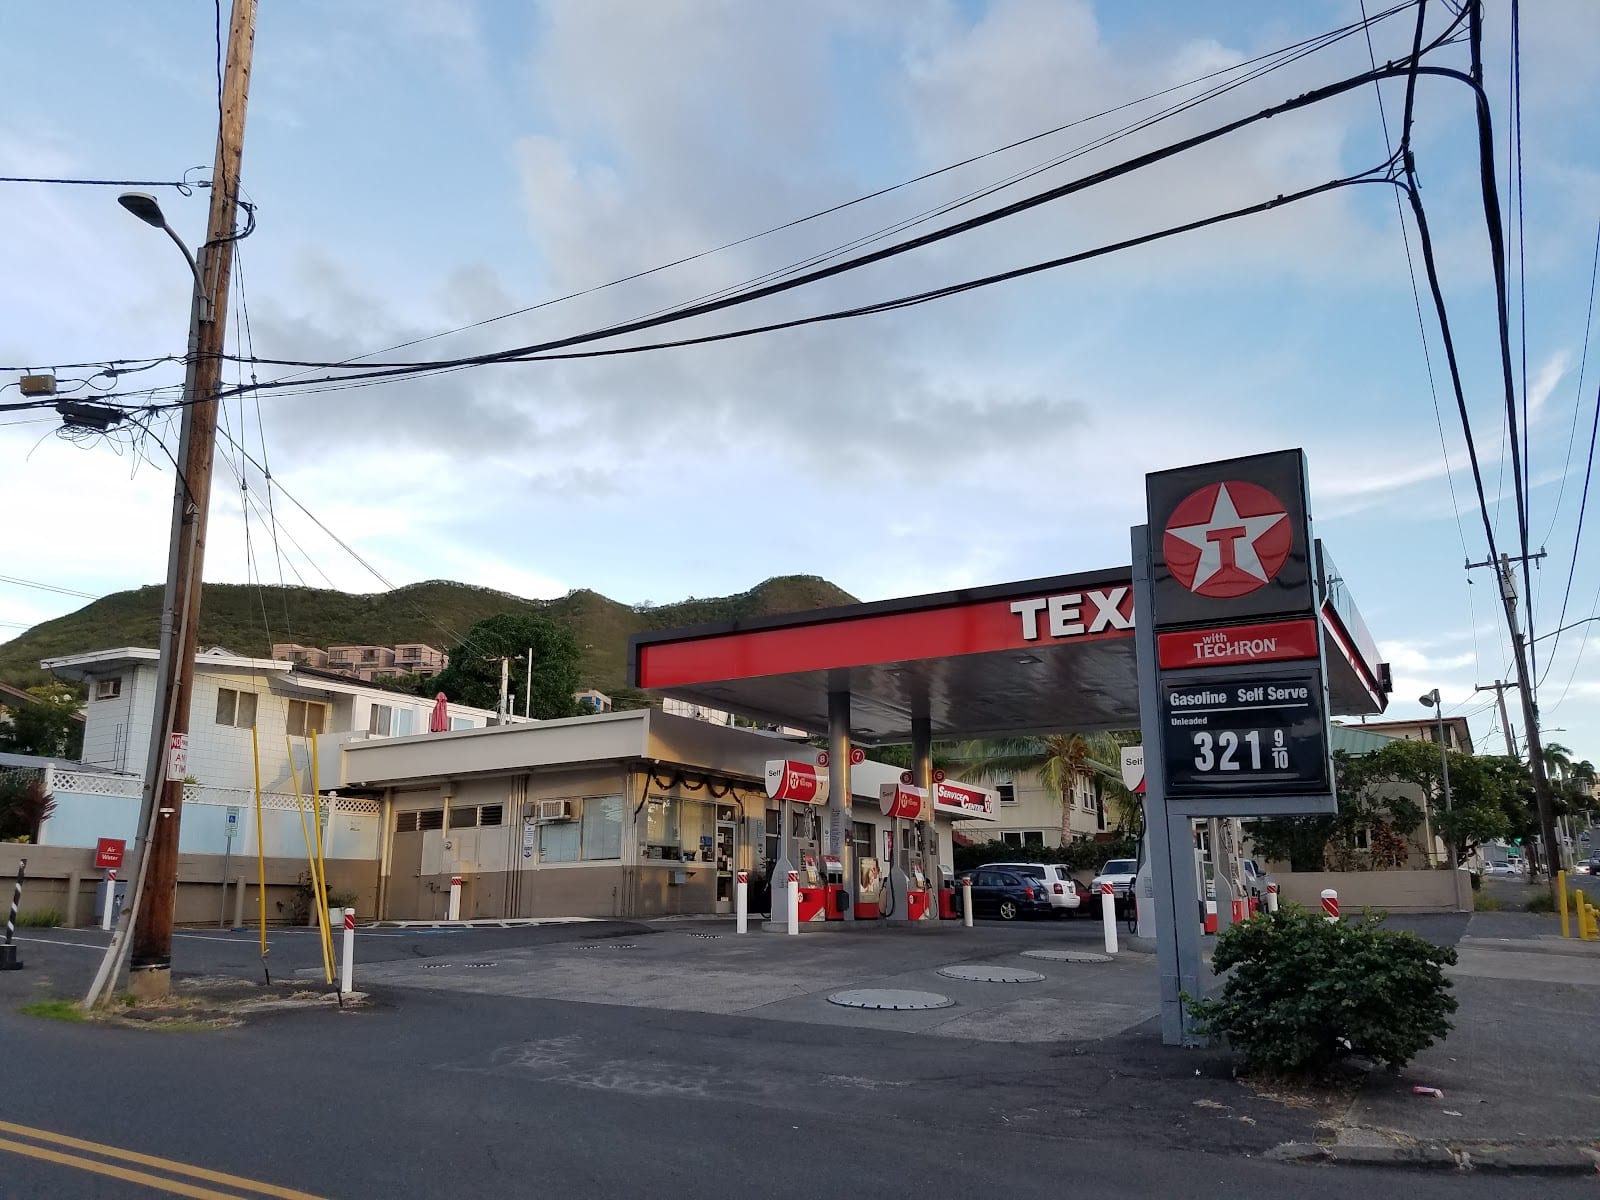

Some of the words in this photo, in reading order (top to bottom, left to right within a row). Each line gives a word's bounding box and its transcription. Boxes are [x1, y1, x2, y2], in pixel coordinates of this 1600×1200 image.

[1010, 587, 1135, 640] TEX
[1202, 632, 1228, 644] with
[1193, 638, 1277, 659] TECHRON
[1170, 691, 1227, 706] Gasoline
[1237, 687, 1264, 702] Self
[1267, 686, 1308, 701] Serve
[1171, 717, 1208, 726] Unleaded
[1274, 729, 1284, 747] 9
[855, 752, 861, 760] 7
[1193, 730, 1261, 772] 321
[1272, 750, 1289, 769] 10
[1125, 758, 1144, 766] Self
